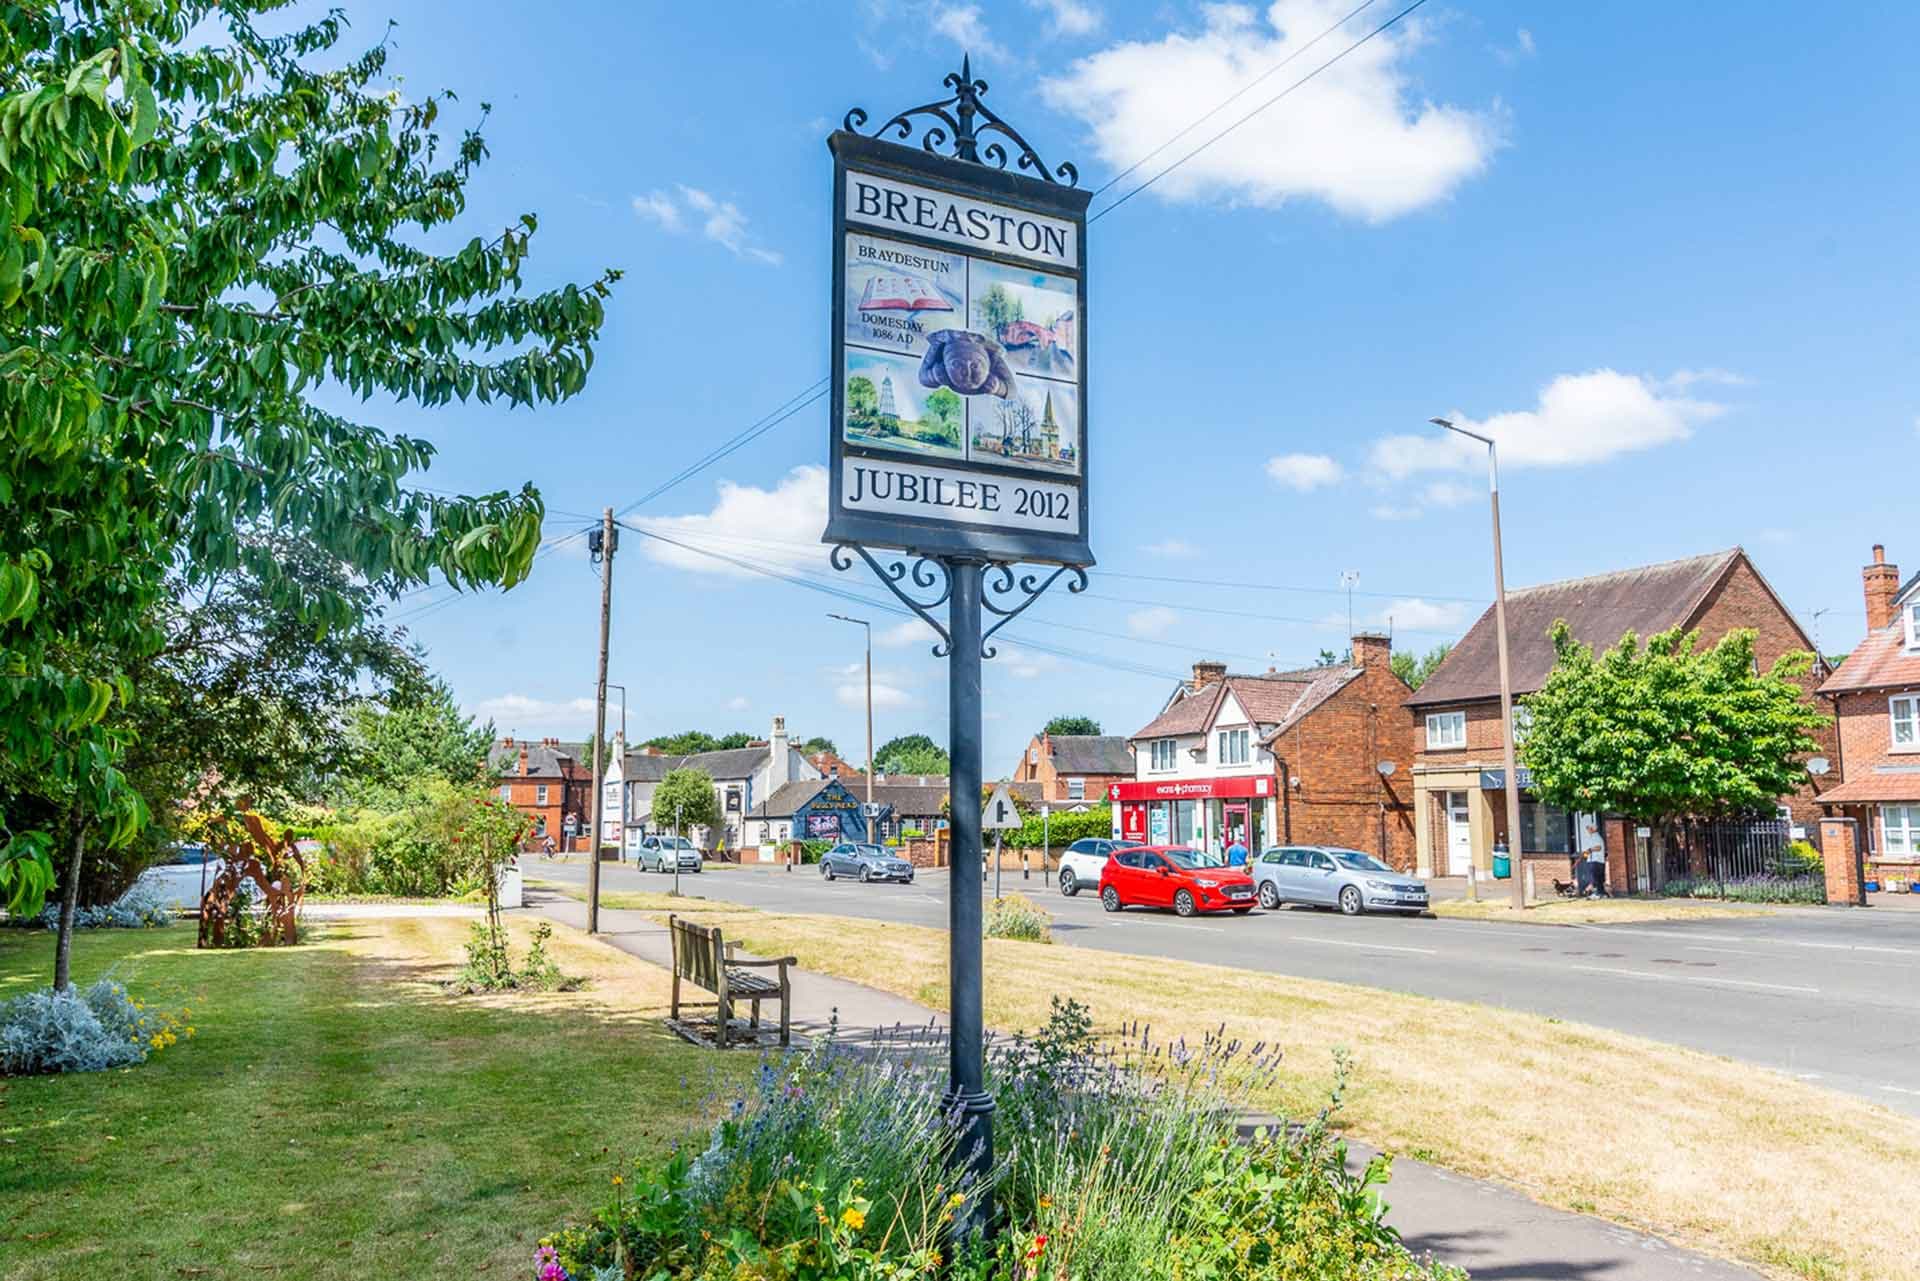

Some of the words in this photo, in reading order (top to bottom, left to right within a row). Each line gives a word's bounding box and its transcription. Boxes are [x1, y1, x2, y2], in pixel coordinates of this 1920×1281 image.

[855, 182, 1067, 258] BREASTON
[858, 244, 950, 273] BRAYDESTUN
[862, 311, 924, 333] DOMESDAY
[896, 333, 914, 344] AD
[849, 467, 1001, 512] JUBILEE
[1014, 487, 1070, 521] 2012
